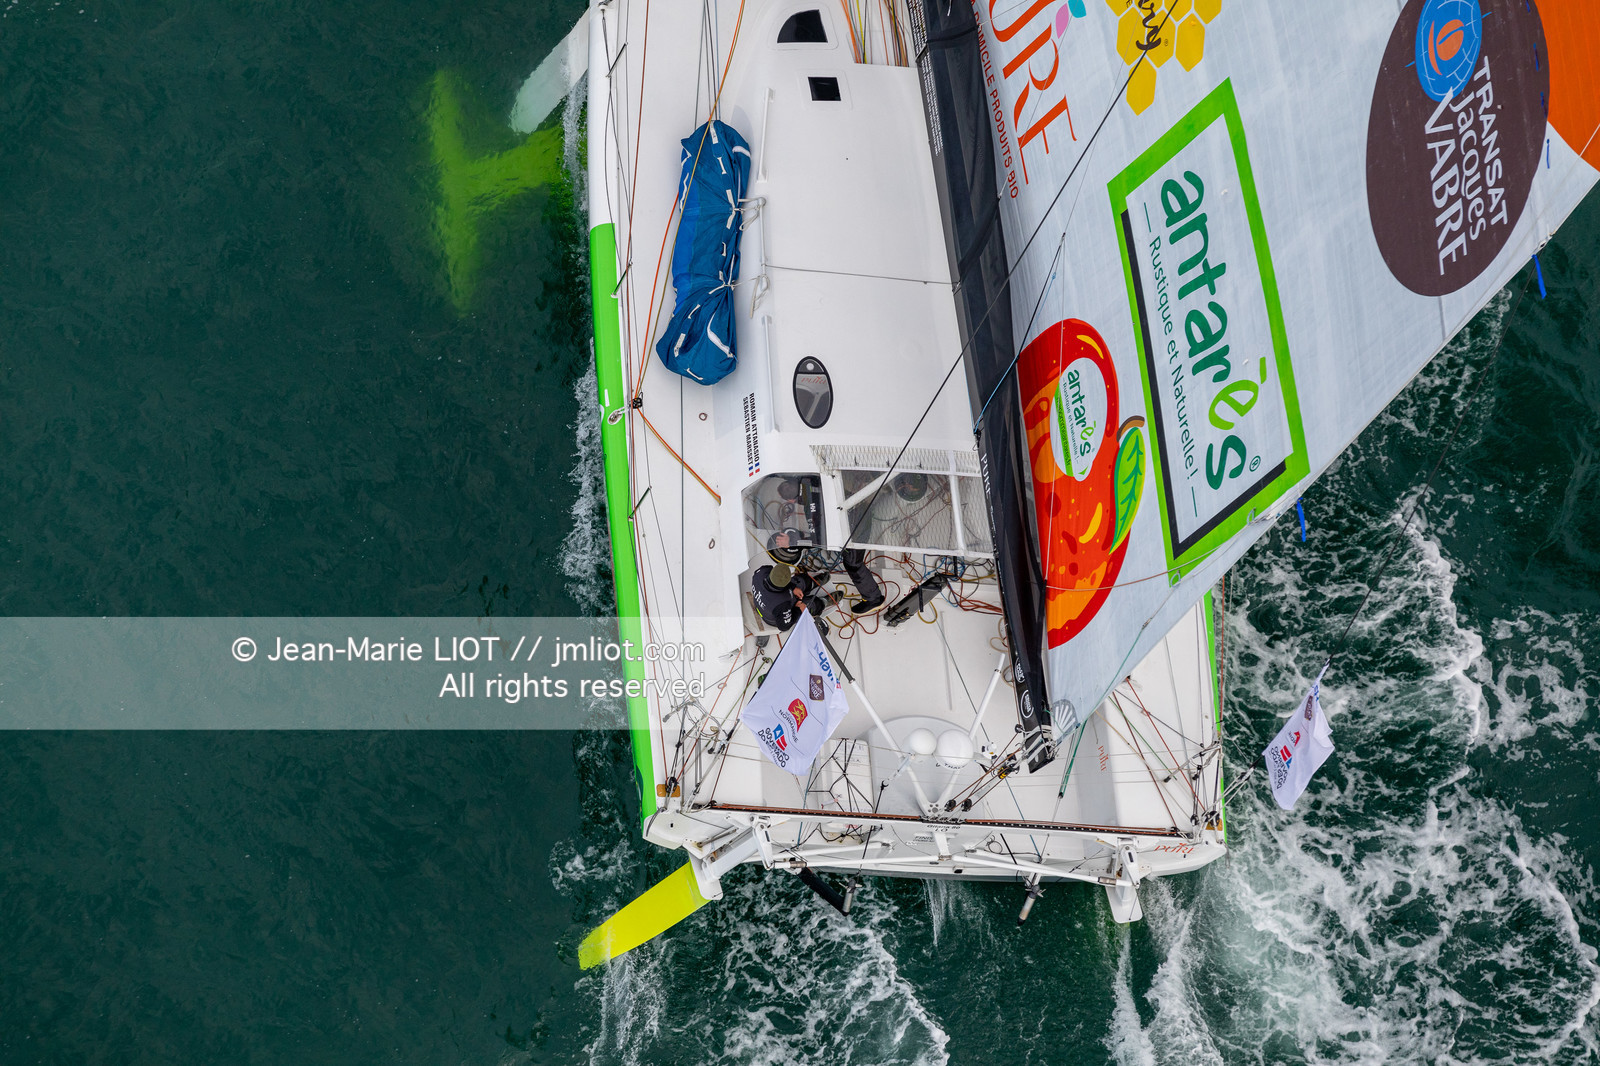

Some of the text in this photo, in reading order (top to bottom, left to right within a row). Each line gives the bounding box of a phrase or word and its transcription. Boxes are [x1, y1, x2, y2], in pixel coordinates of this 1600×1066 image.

[974, 11, 995, 87] DOMICILE
[989, 89, 1012, 168] PRODUITS
[1007, 170, 1019, 199] BIO
[1424, 86, 1468, 276] VABRE
[1473, 56, 1508, 225] TRANSAT
[1149, 235, 1173, 335] Rustique
[1167, 339, 1179, 365] et
[778, 709, 799, 743] NORMANDIE
